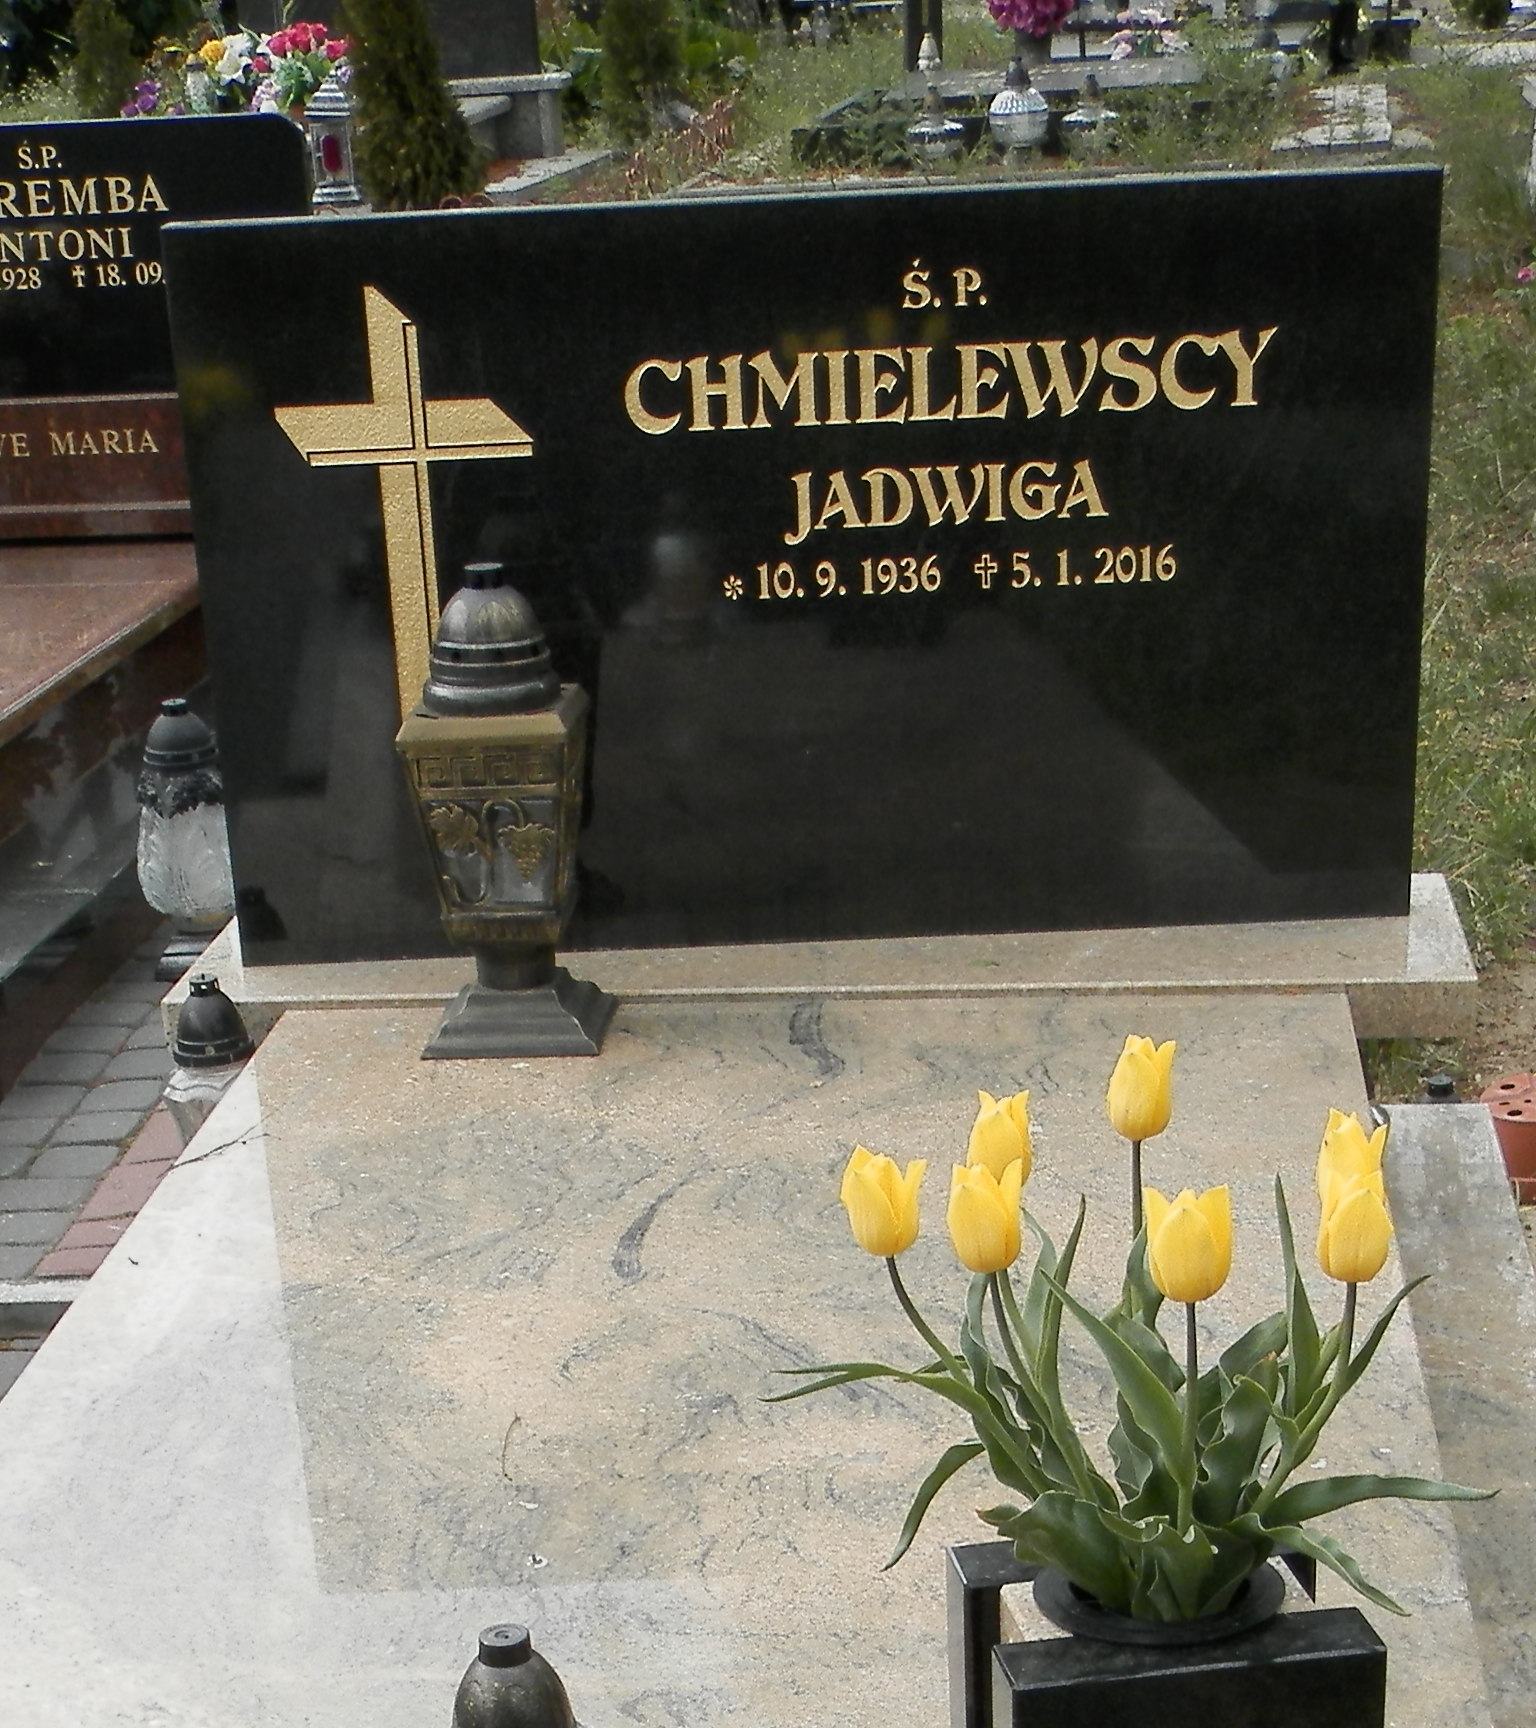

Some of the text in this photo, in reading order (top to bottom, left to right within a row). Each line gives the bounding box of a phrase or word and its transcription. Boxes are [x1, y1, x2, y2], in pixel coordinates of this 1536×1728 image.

[96, 263, 127, 287] 18.
[624, 326, 1279, 435] CHMIELEWSCY
[49, 429, 159, 455] MARIA
[784, 459, 1110, 546] JADWIGA
[756, 543, 1177, 600] 10. 9. 1936 5. 1. 2016
